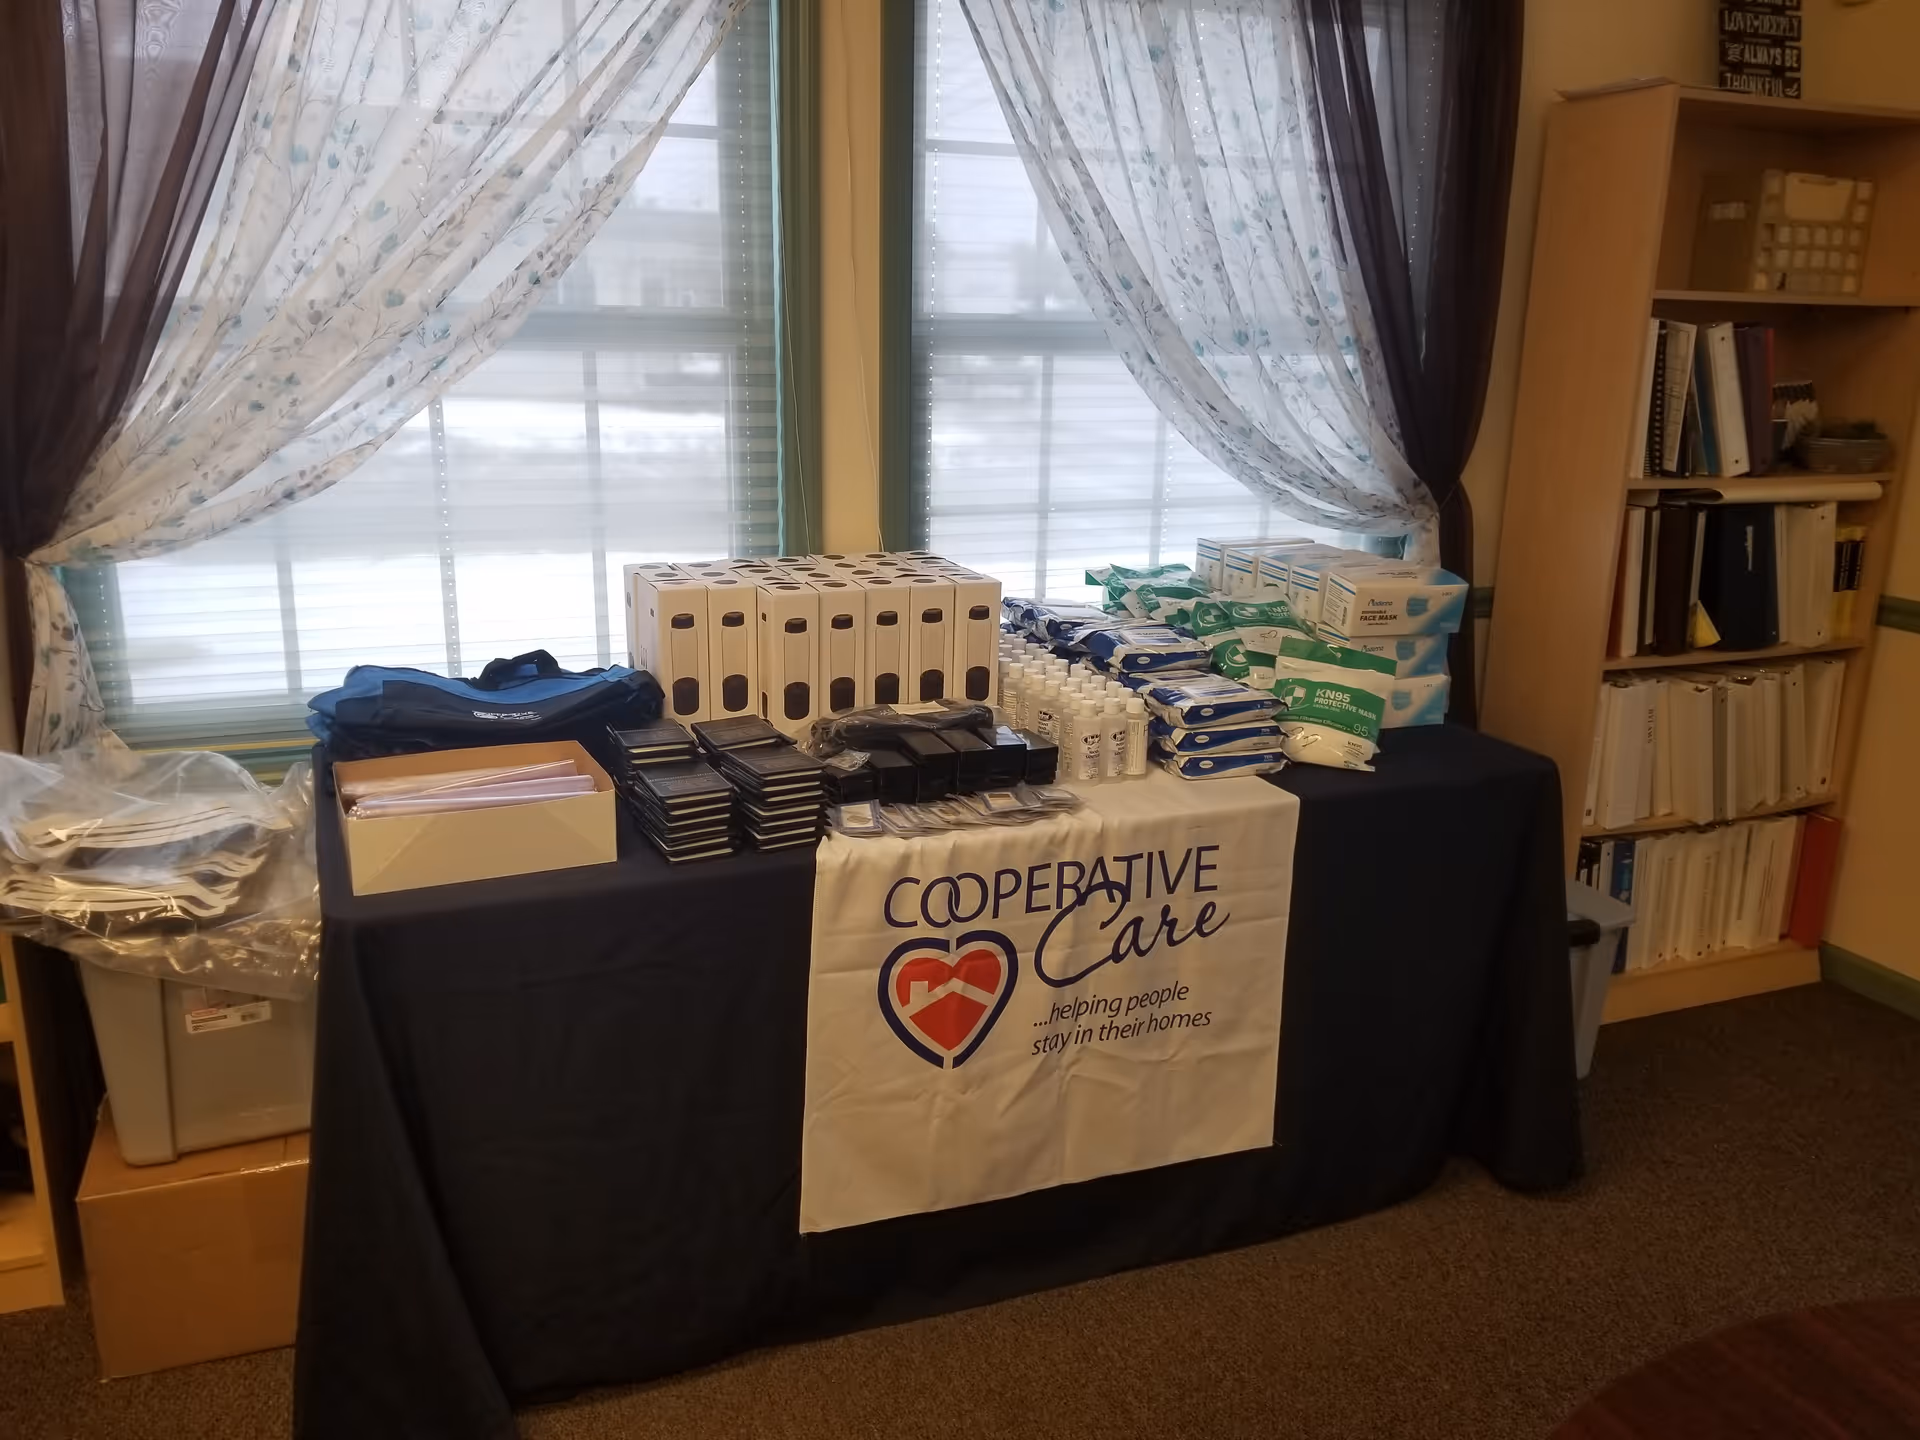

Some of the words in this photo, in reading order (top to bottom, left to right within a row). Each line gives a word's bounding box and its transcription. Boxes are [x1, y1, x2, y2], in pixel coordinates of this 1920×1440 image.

[1724, 10, 1754, 33] LOVE
[1744, 44, 1782, 65] ALWAYS
[1785, 48, 1799, 68] BE
[1724, 73, 1785, 97] THANKFUL
[1315, 688, 1352, 703] KN95
[1313, 696, 1358, 713] PROTECTIVE
[1358, 708, 1377, 721] MASK
[1352, 723, 1369, 738] 95
[883, 844, 1220, 928] COOPERATIVE
[1033, 881, 1231, 989] Care
[1124, 980, 1190, 1017] people
[1031, 1030, 1072, 1057] stay
[1073, 1023, 1094, 1045] in
[1098, 1016, 1146, 1042] their
[1146, 1010, 1213, 1034] homes
